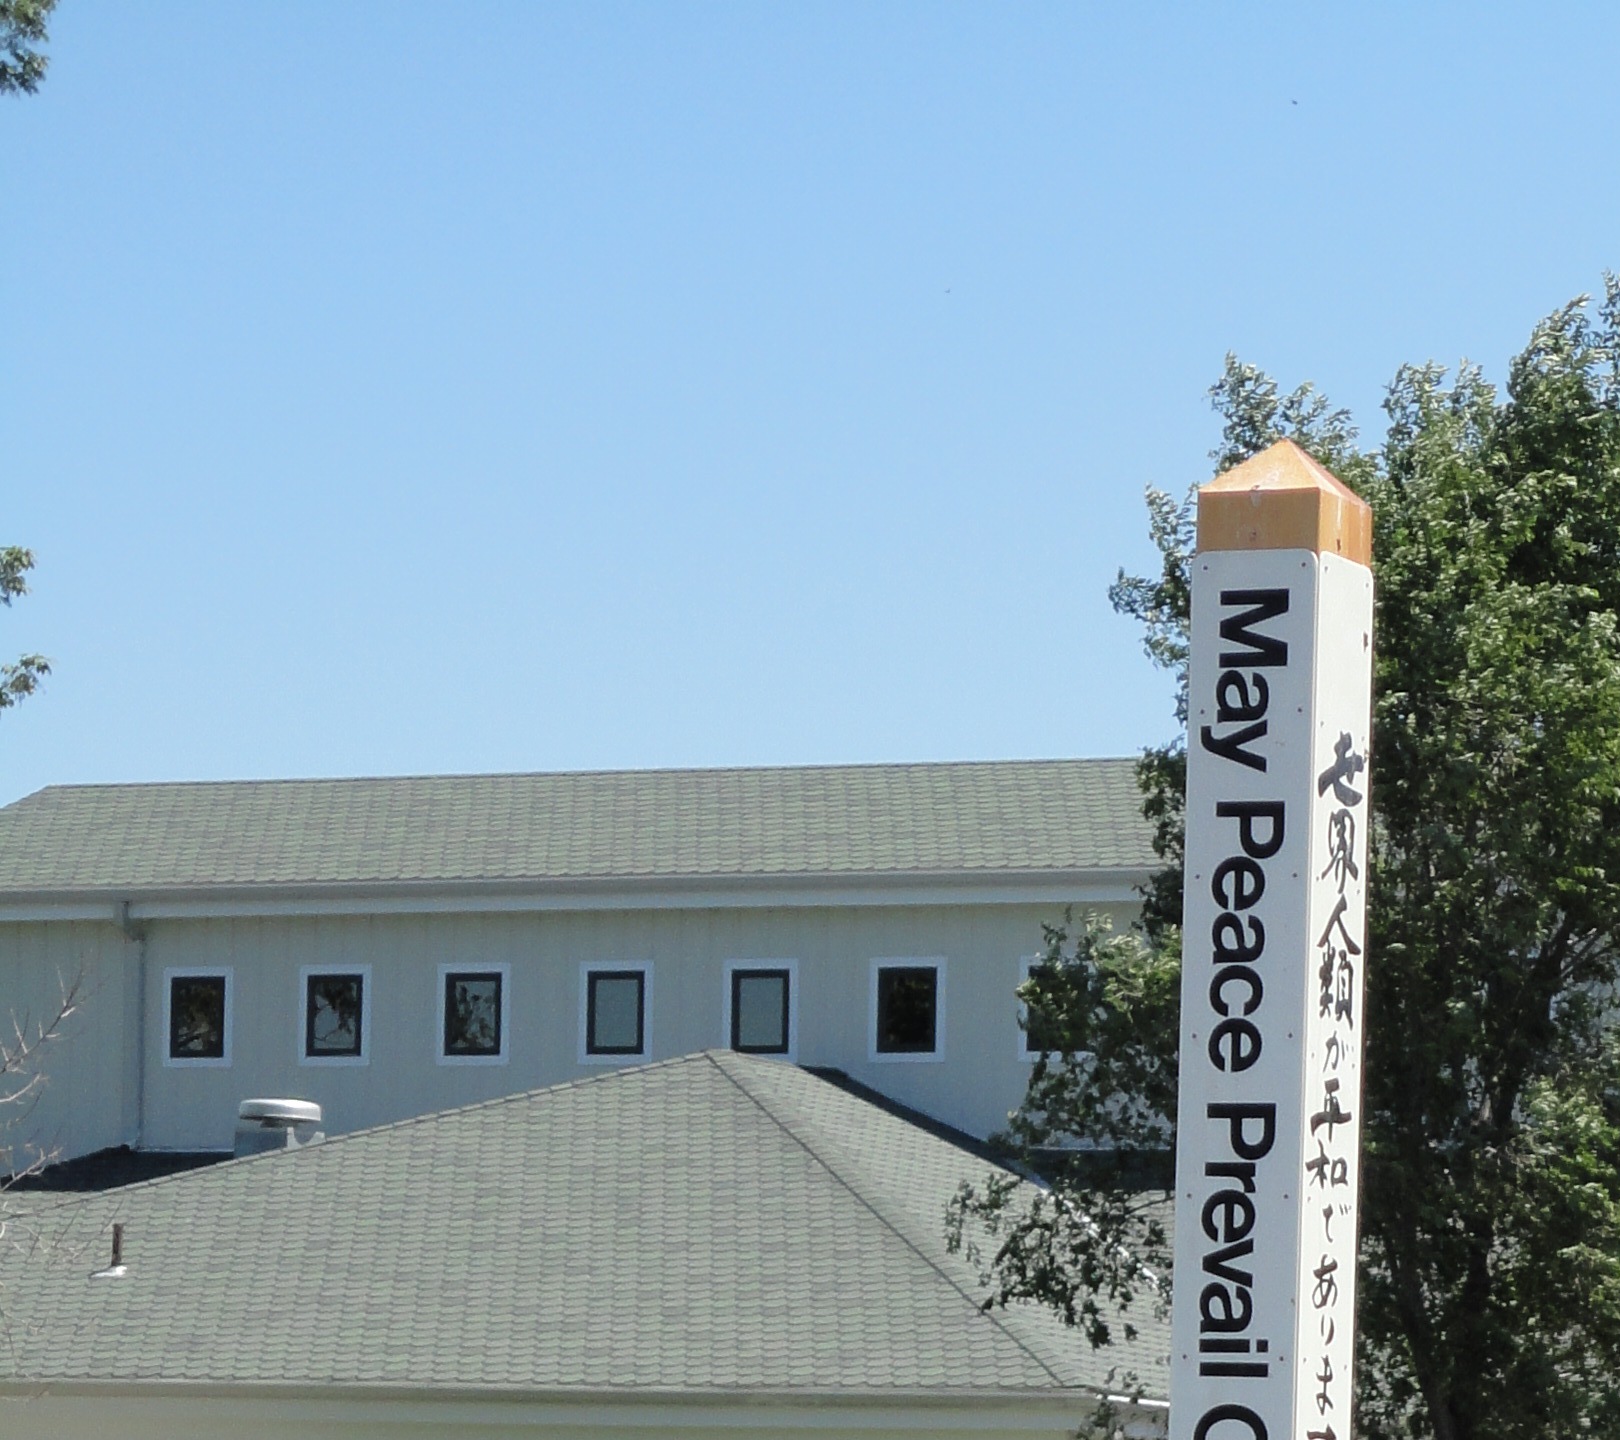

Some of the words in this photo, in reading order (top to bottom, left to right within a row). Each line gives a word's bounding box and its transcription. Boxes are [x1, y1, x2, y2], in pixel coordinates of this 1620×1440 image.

[1201, 589, 1289, 773] May
[1208, 801, 1285, 1072] Peace
[1199, 1103, 1275, 1377] Prevail
